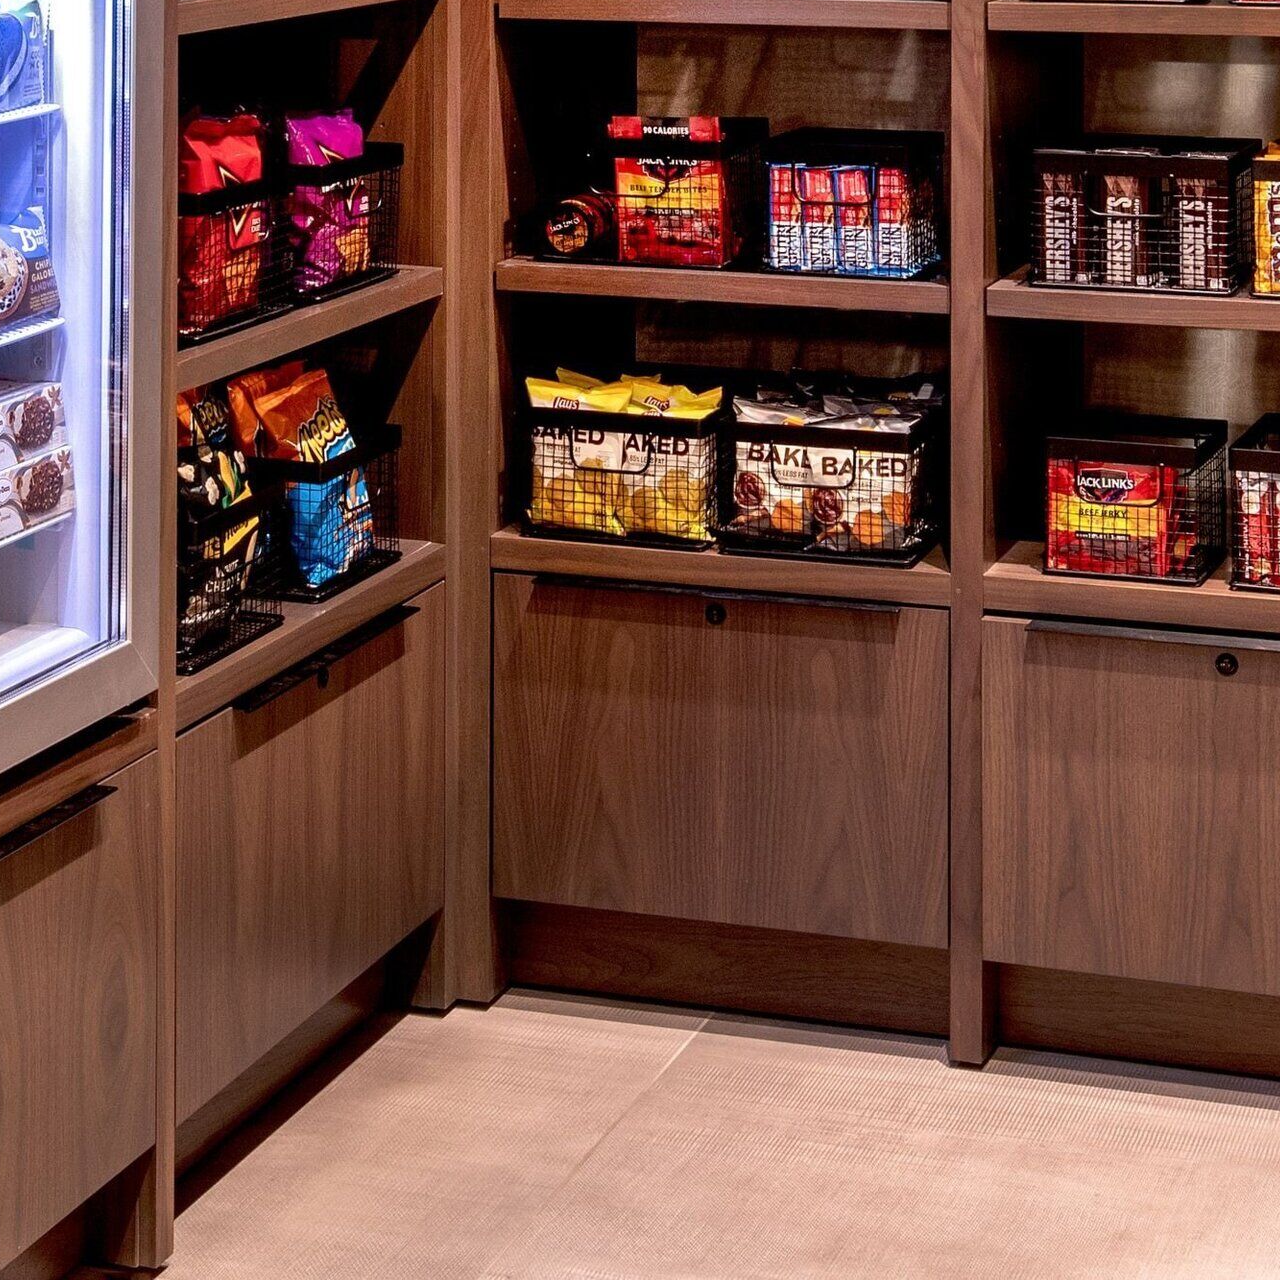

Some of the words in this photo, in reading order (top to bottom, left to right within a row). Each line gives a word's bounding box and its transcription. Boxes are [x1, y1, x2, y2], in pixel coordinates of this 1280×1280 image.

[643, 126, 652, 135] 90
[653, 126, 689, 136] CALORIES
[627, 434, 690, 455] AKED
[821, 456, 908, 479] BAKED
[1101, 476, 1135, 491] LINK'S
